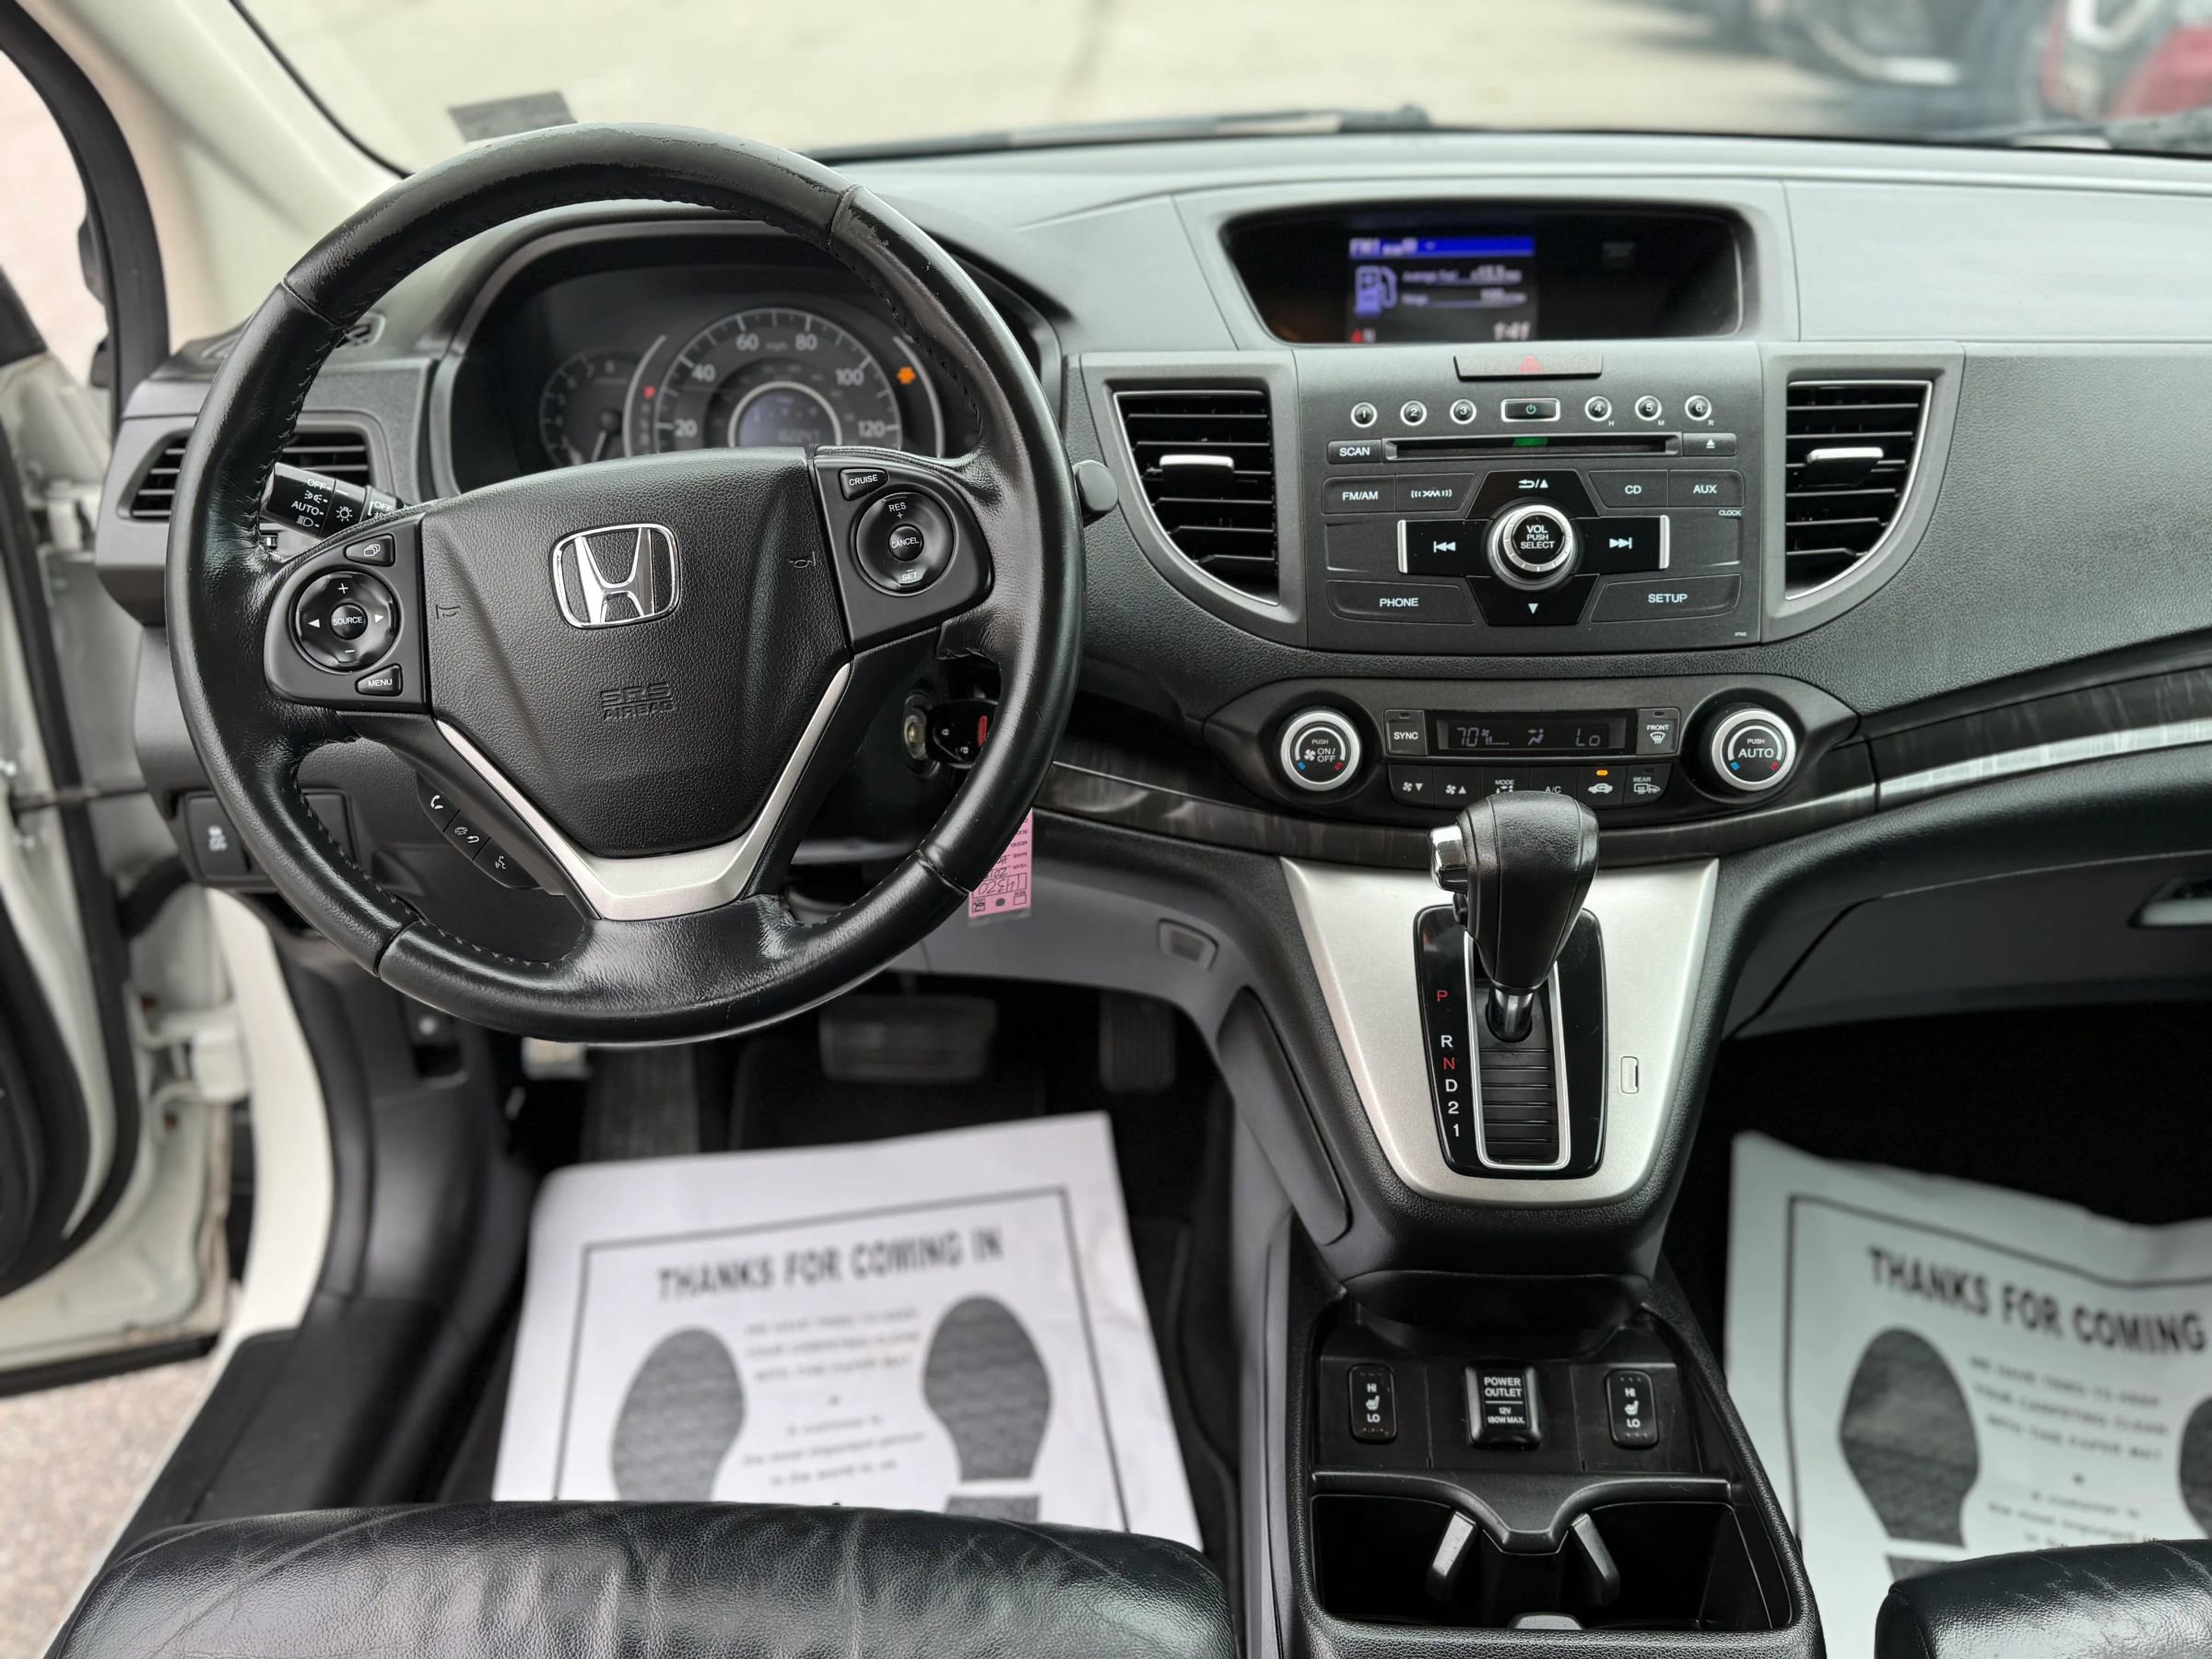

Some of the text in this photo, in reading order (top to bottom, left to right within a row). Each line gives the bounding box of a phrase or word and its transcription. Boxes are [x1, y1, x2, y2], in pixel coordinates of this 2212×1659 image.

[736, 333, 759, 351] 60
[794, 333, 818, 351] 80
[692, 364, 717, 382] 40
[836, 369, 865, 386] 100
[1410, 407, 1418, 417] 2
[1459, 406, 1467, 416] 3
[1594, 404, 1602, 413] 4
[1645, 403, 1653, 412] 5
[1695, 403, 1703, 412] 6
[674, 418, 698, 437] 20
[858, 420, 885, 438] 120
[1339, 447, 1371, 457] SCAN
[307, 478, 327, 489] OFF
[849, 474, 878, 487] CRUISE
[1624, 485, 1642, 494] CD
[1692, 484, 1718, 494] AUX
[1342, 490, 1379, 500] FM/AM
[291, 500, 320, 516] AUTO
[888, 501, 907, 512] RES
[1718, 509, 1742, 517] CLOCK
[1526, 524, 1548, 534] VOL
[891, 536, 920, 549] CANCEL
[1520, 541, 1556, 549] SELECT
[901, 571, 917, 582] SET
[1379, 597, 1419, 607] PHONE
[1648, 593, 1688, 604] SETUP
[333, 616, 363, 626] SOURCE
[368, 678, 393, 688] MENU
[600, 682, 671, 704] SRS
[604, 700, 674, 720] AIRBAG
[1394, 731, 1419, 740] SYNC
[1738, 747, 1774, 759] AUTO
[1317, 755, 1335, 763] OFF
[1437, 990, 1449, 1003] P
[1441, 1034, 1453, 1048] R
[1443, 1057, 1455, 1070] N
[1445, 1078, 1458, 1092] D
[1447, 1100, 1459, 1114] 2
[1453, 1123, 1460, 1137] 1
[657, 1226, 1005, 1300] THANKS FOR COMING IN
[1867, 1245, 2206, 1354] THANKS FOR COMING
[1484, 1376, 1522, 1387] POWER
[1366, 1382, 1377, 1393] HI
[1484, 1387, 1523, 1397] OUTLET
[1624, 1387, 1636, 1397] HI
[1499, 1406, 1512, 1416] 12V
[1366, 1413, 1381, 1423] LO
[1626, 1418, 1641, 1429] LO
